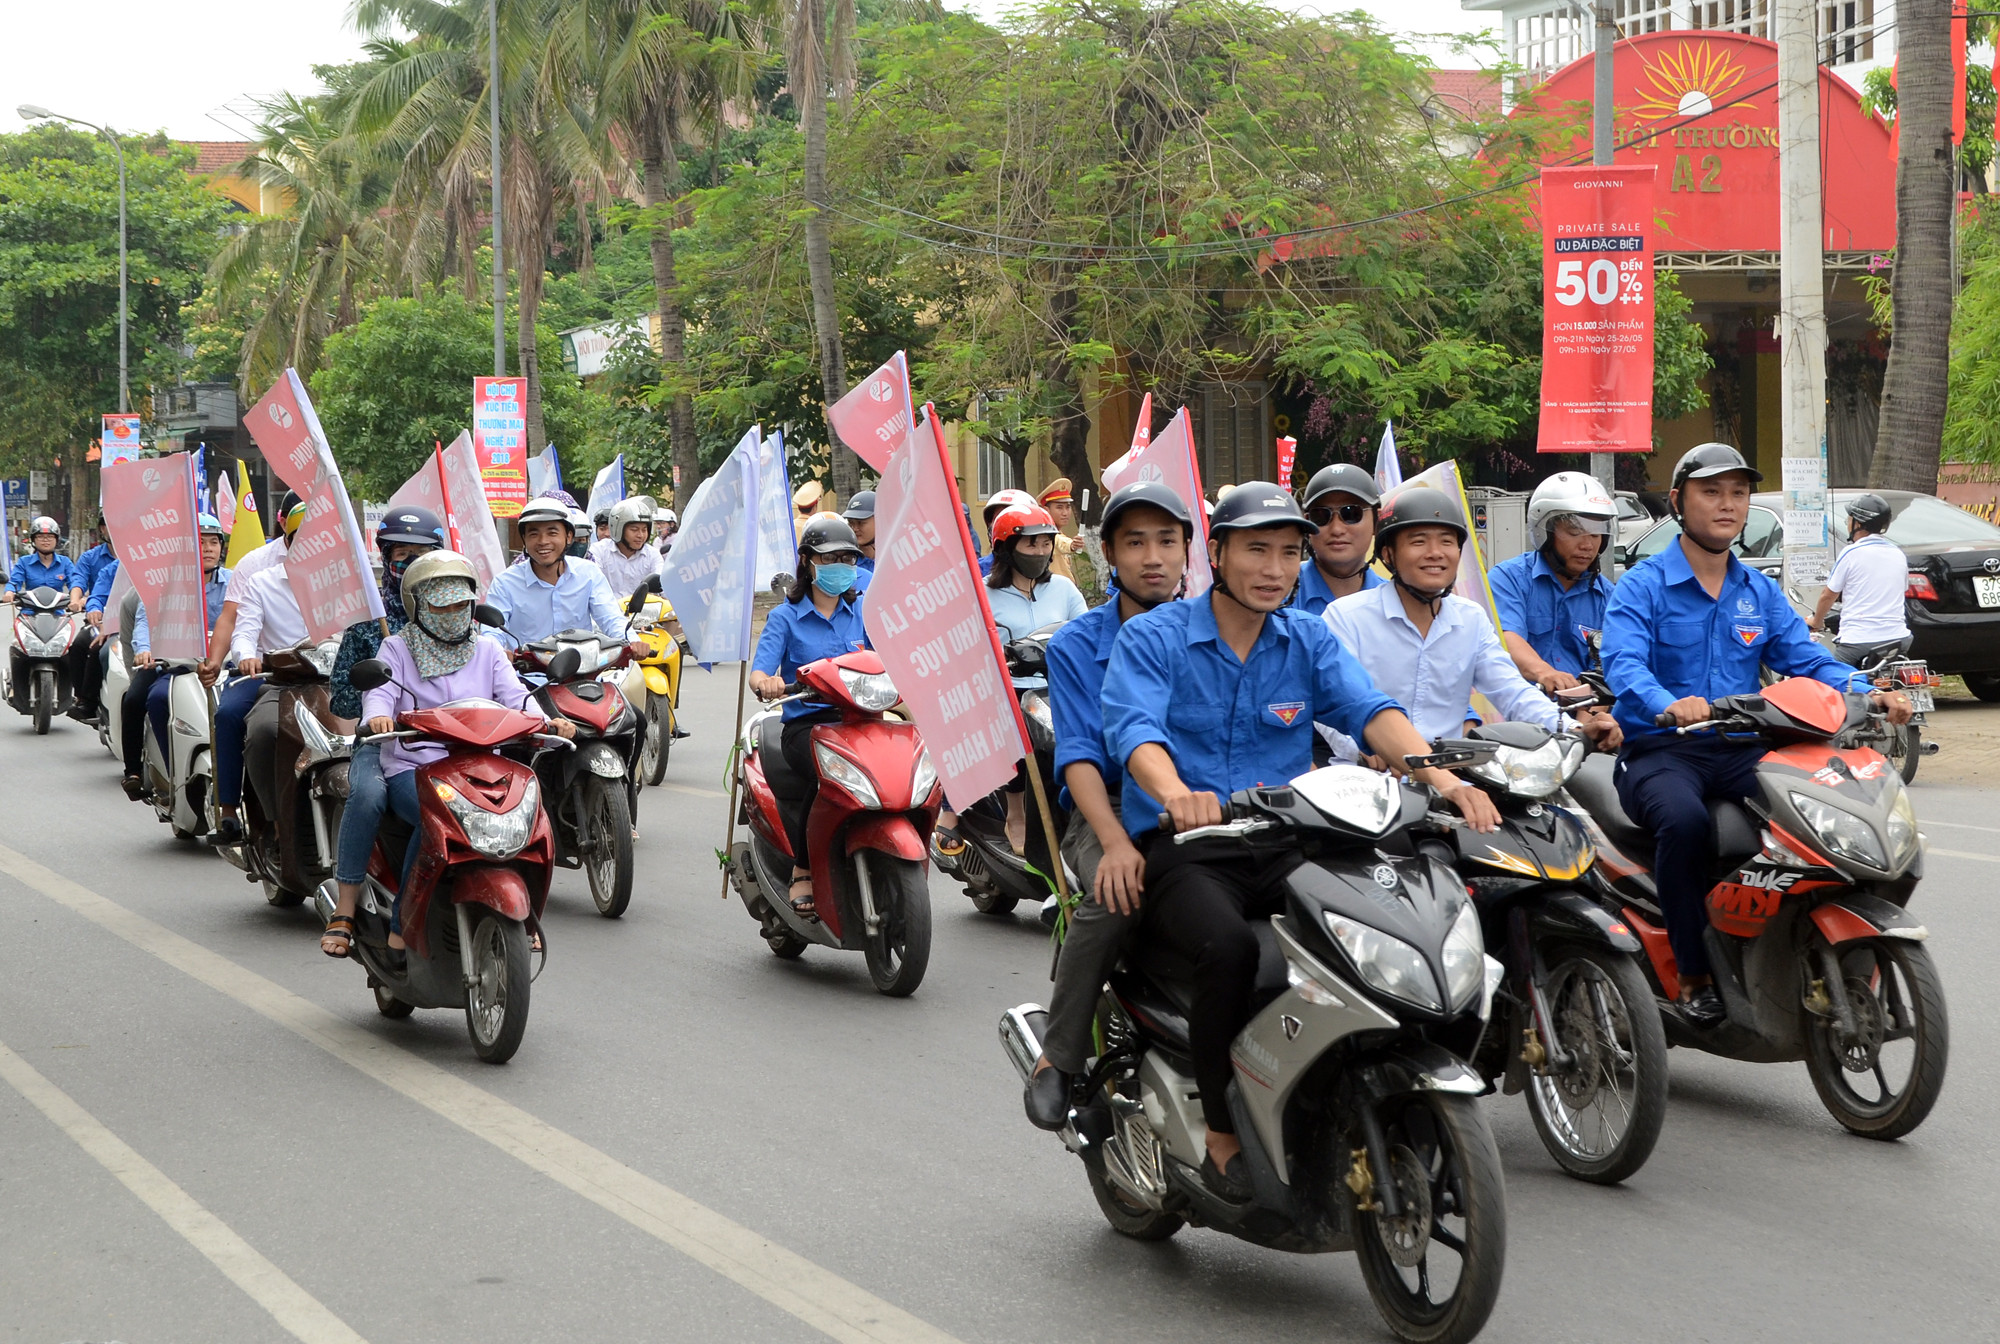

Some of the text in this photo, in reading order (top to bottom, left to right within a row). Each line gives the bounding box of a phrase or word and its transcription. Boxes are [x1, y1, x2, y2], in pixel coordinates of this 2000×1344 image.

[1670, 154, 1722, 192] A2
[1573, 180, 1623, 190] GIOVANNI
[1557, 222, 1641, 233] PRIVATE SALE
[1556, 237, 1640, 252] ƯU ĐÃI ĐẶC BIỆT
[1620, 257, 1643, 271] ĐẾN
[1554, 258, 1619, 306] 50
[1553, 318, 1644, 331] HƠN 15.000 SẢN PHẨM
[1553, 334, 1643, 345] 09h-21h Ngày 25-26/05
[1559, 345, 1637, 355] 09h-15h Ngày 27/05
[486, 382, 517, 399] HỘI CHỢ
[500, 399, 519, 413] TIẾN
[478, 417, 525, 432] THƯƠNG MẠI
[506, 435, 518, 447] AN
[491, 452, 510, 464] 2018
[8, 480, 20, 494] P
[1739, 869, 1804, 892] DUKE
